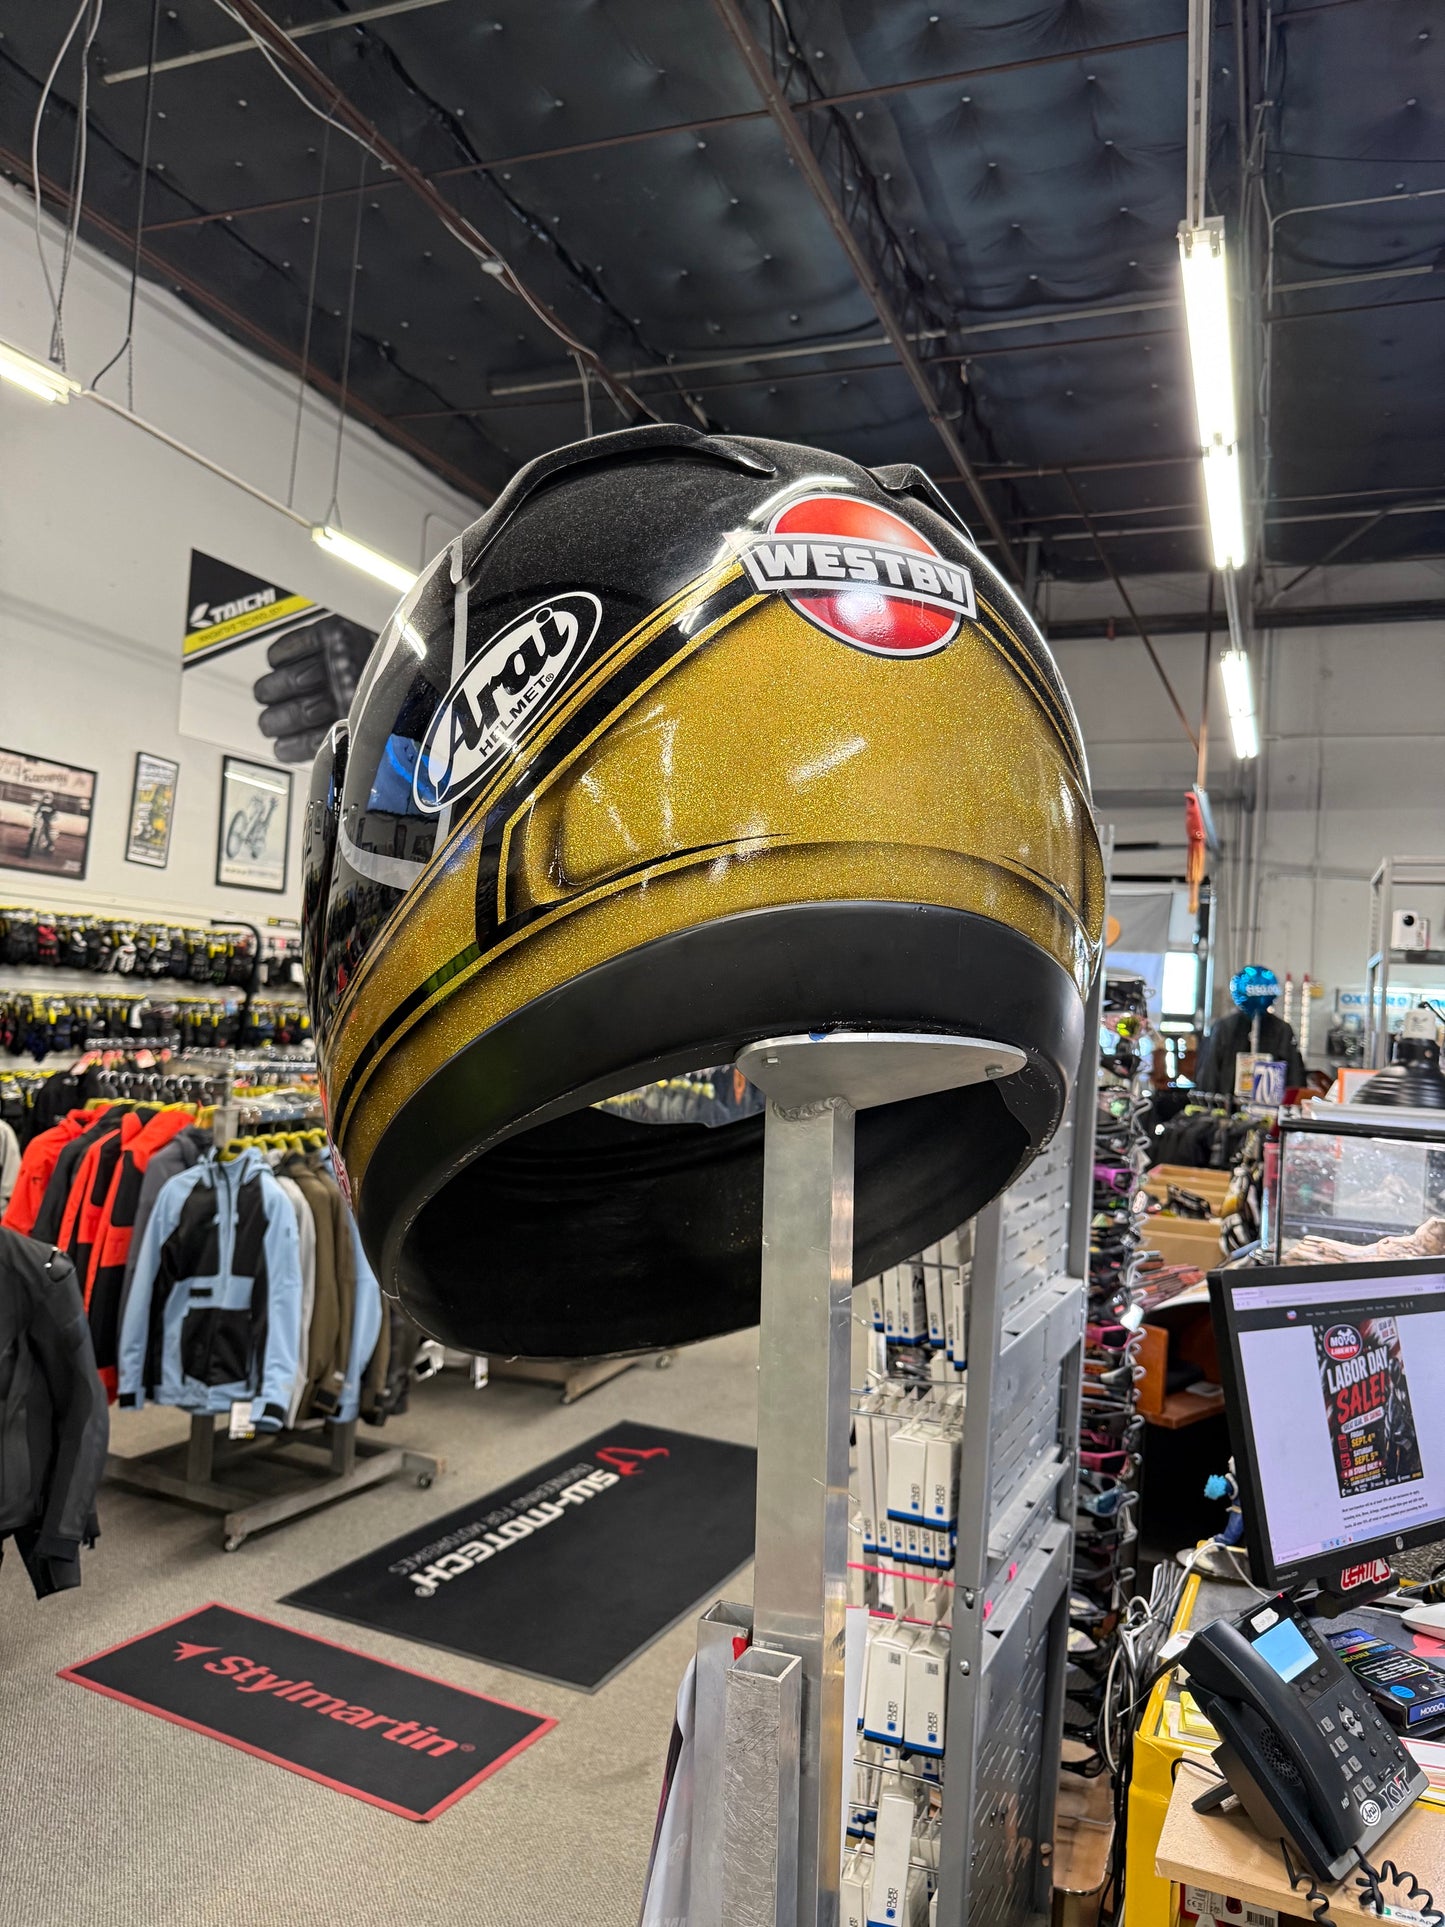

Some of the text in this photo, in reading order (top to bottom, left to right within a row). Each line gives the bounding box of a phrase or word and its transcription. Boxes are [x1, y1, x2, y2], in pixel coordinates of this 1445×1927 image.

[753, 543, 965, 604] WESTBY
[428, 608, 578, 803] Arai
[1330, 1336, 1356, 1347] MOTO
[1327, 1346, 1388, 1394] LABOR DAY
[1336, 1371, 1386, 1423] SALE!
[1378, 1766, 1411, 1811] KYT
[1395, 1911, 1417, 1922] Cash
